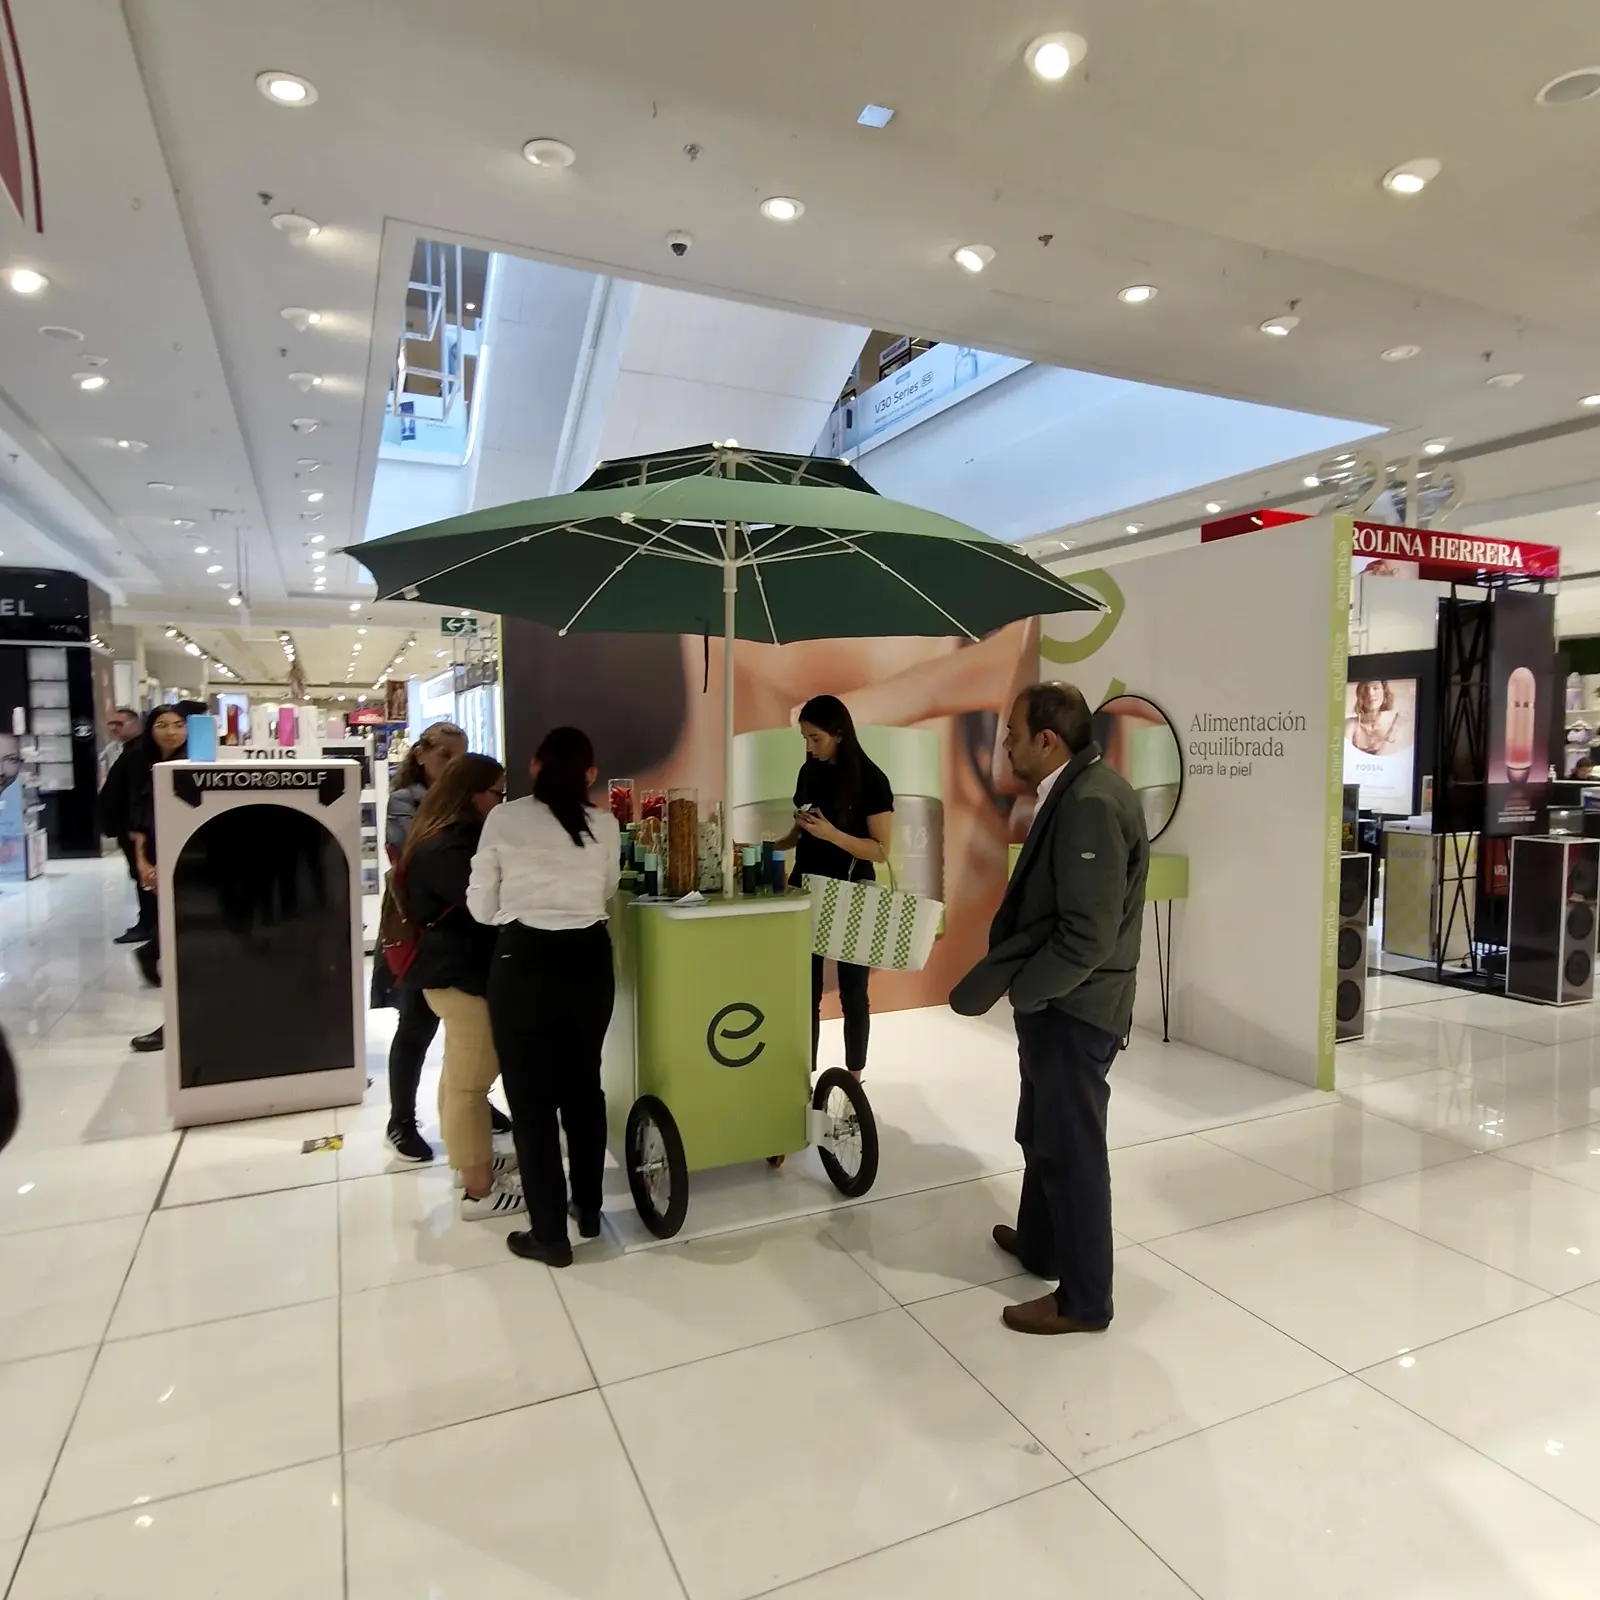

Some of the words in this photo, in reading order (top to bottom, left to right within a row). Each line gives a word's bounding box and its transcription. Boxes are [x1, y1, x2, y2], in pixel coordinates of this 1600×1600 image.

[874, 396, 892, 414] V30
[893, 382, 919, 404] Series
[1430, 536, 1524, 569] HERRERA
[1336, 540, 1350, 611] equilibre
[1332, 632, 1346, 702] equilibre
[1189, 710, 1307, 732] Alimentación
[1189, 737, 1284, 761] equilibrada
[1189, 763, 1213, 778] para
[1217, 761, 1227, 776] la
[1230, 761, 1253, 780] piel
